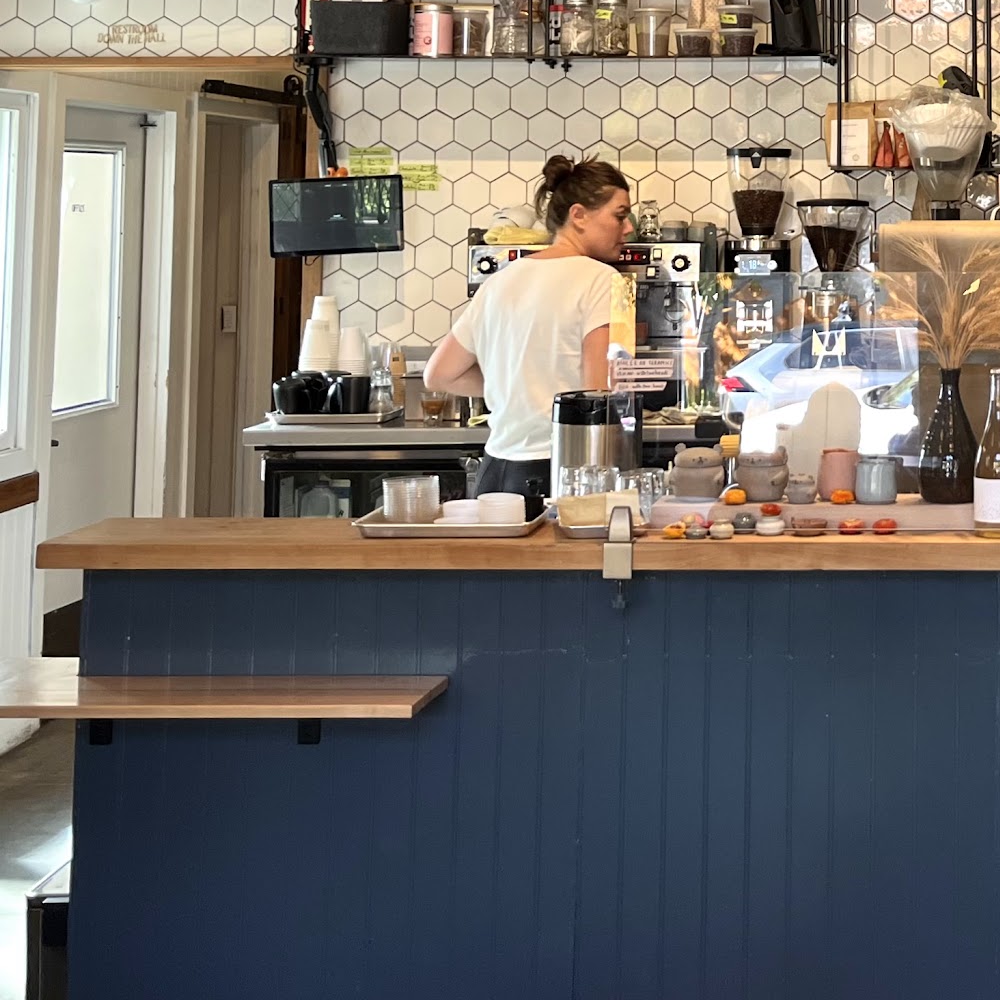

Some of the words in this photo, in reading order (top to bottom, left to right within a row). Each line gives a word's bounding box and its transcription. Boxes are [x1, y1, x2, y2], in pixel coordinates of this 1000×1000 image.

[112, 24, 158, 34] RESTROOM
[97, 33, 124, 44] DOWN
[127, 34, 143, 45] THE
[145, 32, 167, 43] HALL
